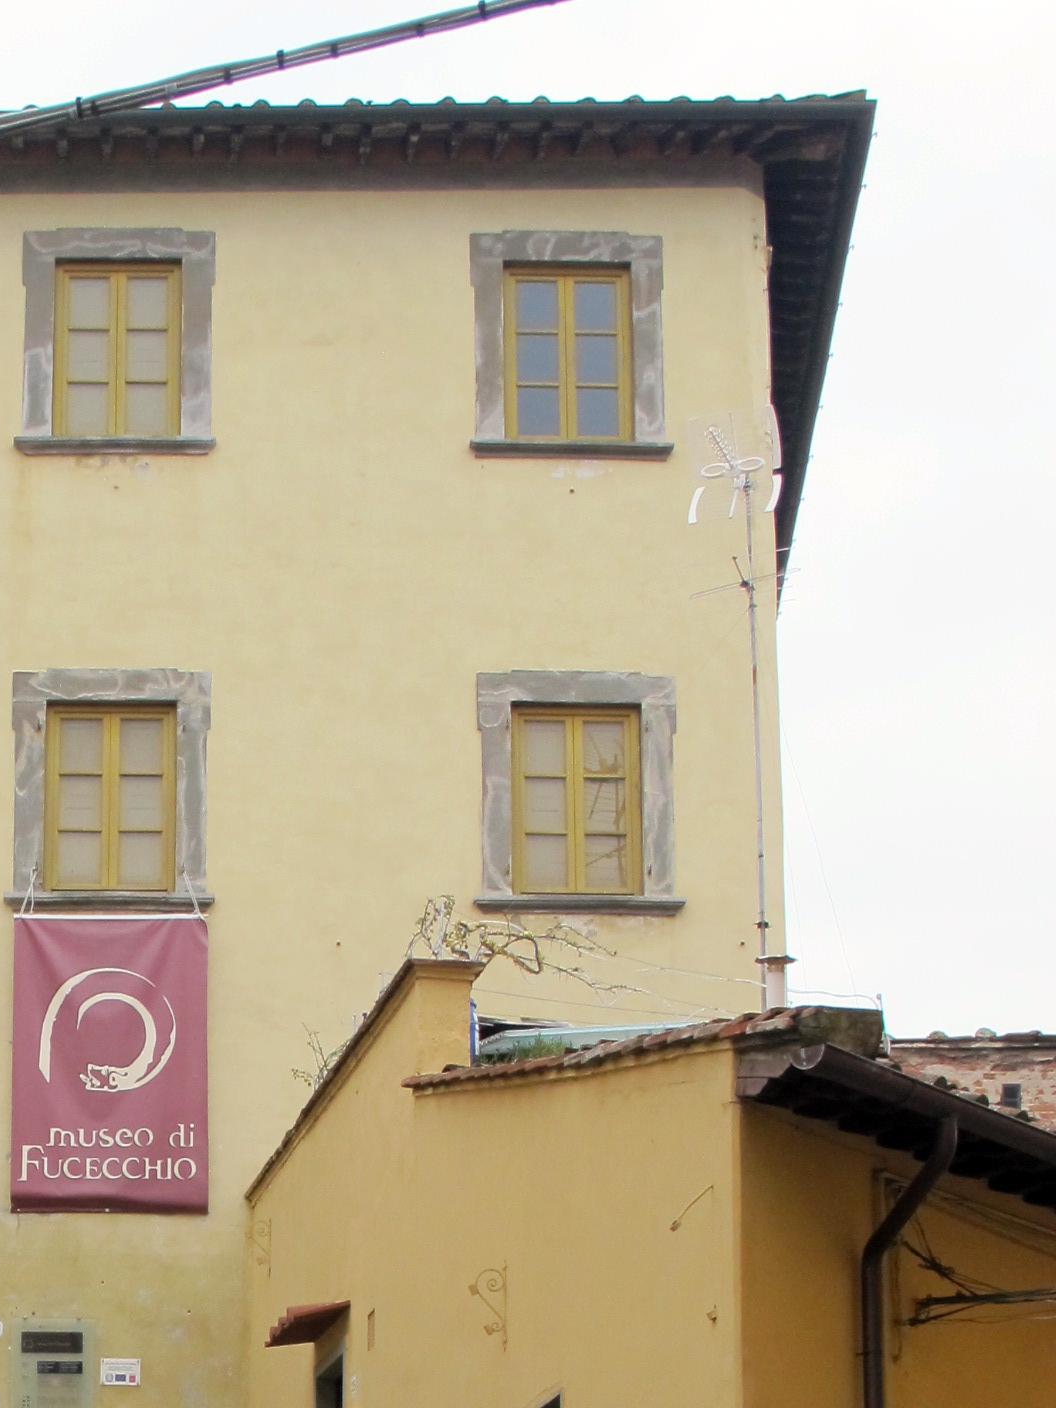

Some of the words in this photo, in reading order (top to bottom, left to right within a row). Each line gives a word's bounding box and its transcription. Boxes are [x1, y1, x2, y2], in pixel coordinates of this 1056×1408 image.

[45, 1127, 154, 1147] museo
[169, 1123, 195, 1148] di
[17, 1144, 197, 1181] FUCECCHIO
